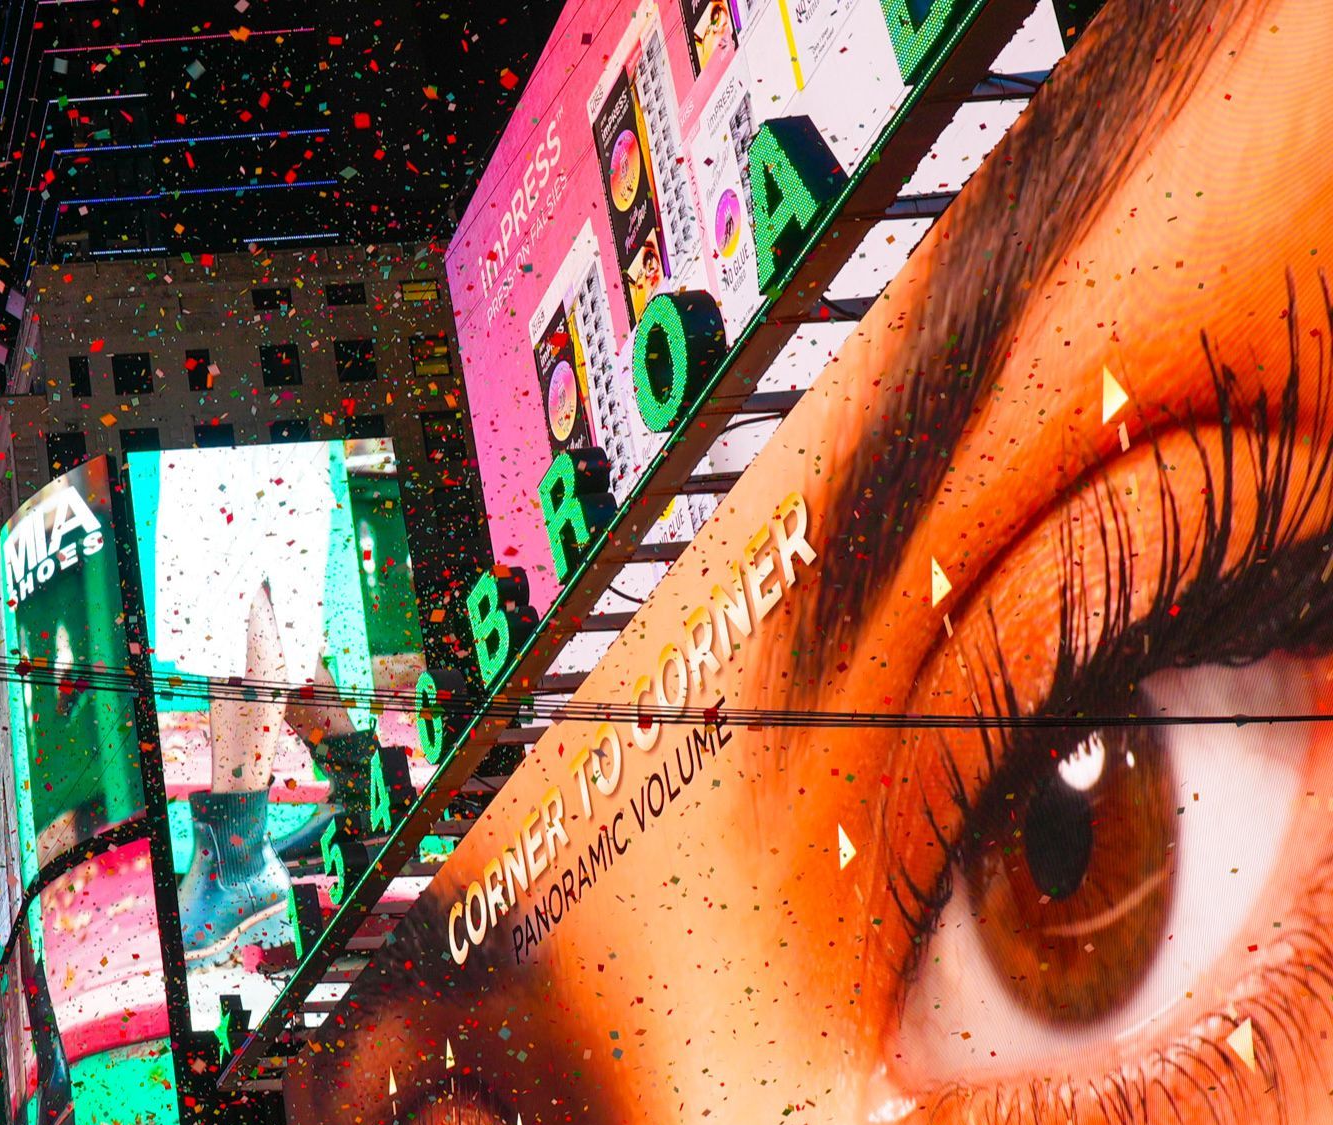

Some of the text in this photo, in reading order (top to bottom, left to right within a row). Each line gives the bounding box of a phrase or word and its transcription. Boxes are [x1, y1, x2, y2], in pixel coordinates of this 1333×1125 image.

[447, 490, 818, 966] CORNER TO CORNER
[512, 696, 733, 966] PANORAMIC VOLUME
